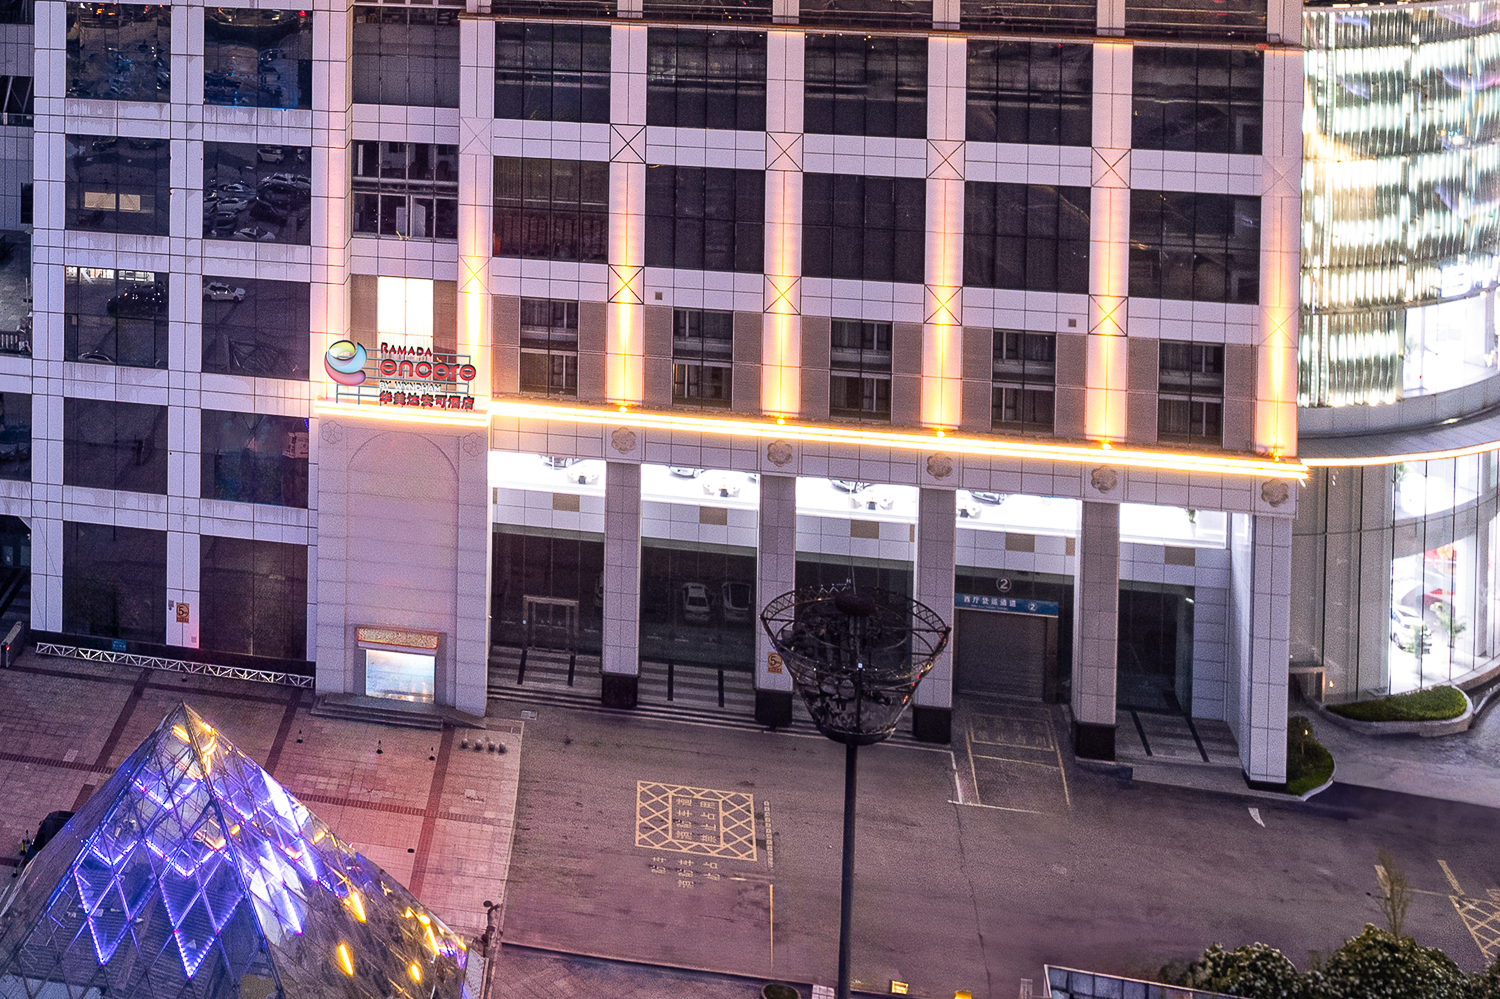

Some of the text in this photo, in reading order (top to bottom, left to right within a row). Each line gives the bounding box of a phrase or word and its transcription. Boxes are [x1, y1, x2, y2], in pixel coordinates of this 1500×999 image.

[381, 342, 432, 357] RAMADA
[380, 359, 476, 381] encore
[380, 380, 441, 392] BY WYNDHAM
[379, 390, 474, 410] 华美达安可酒店
